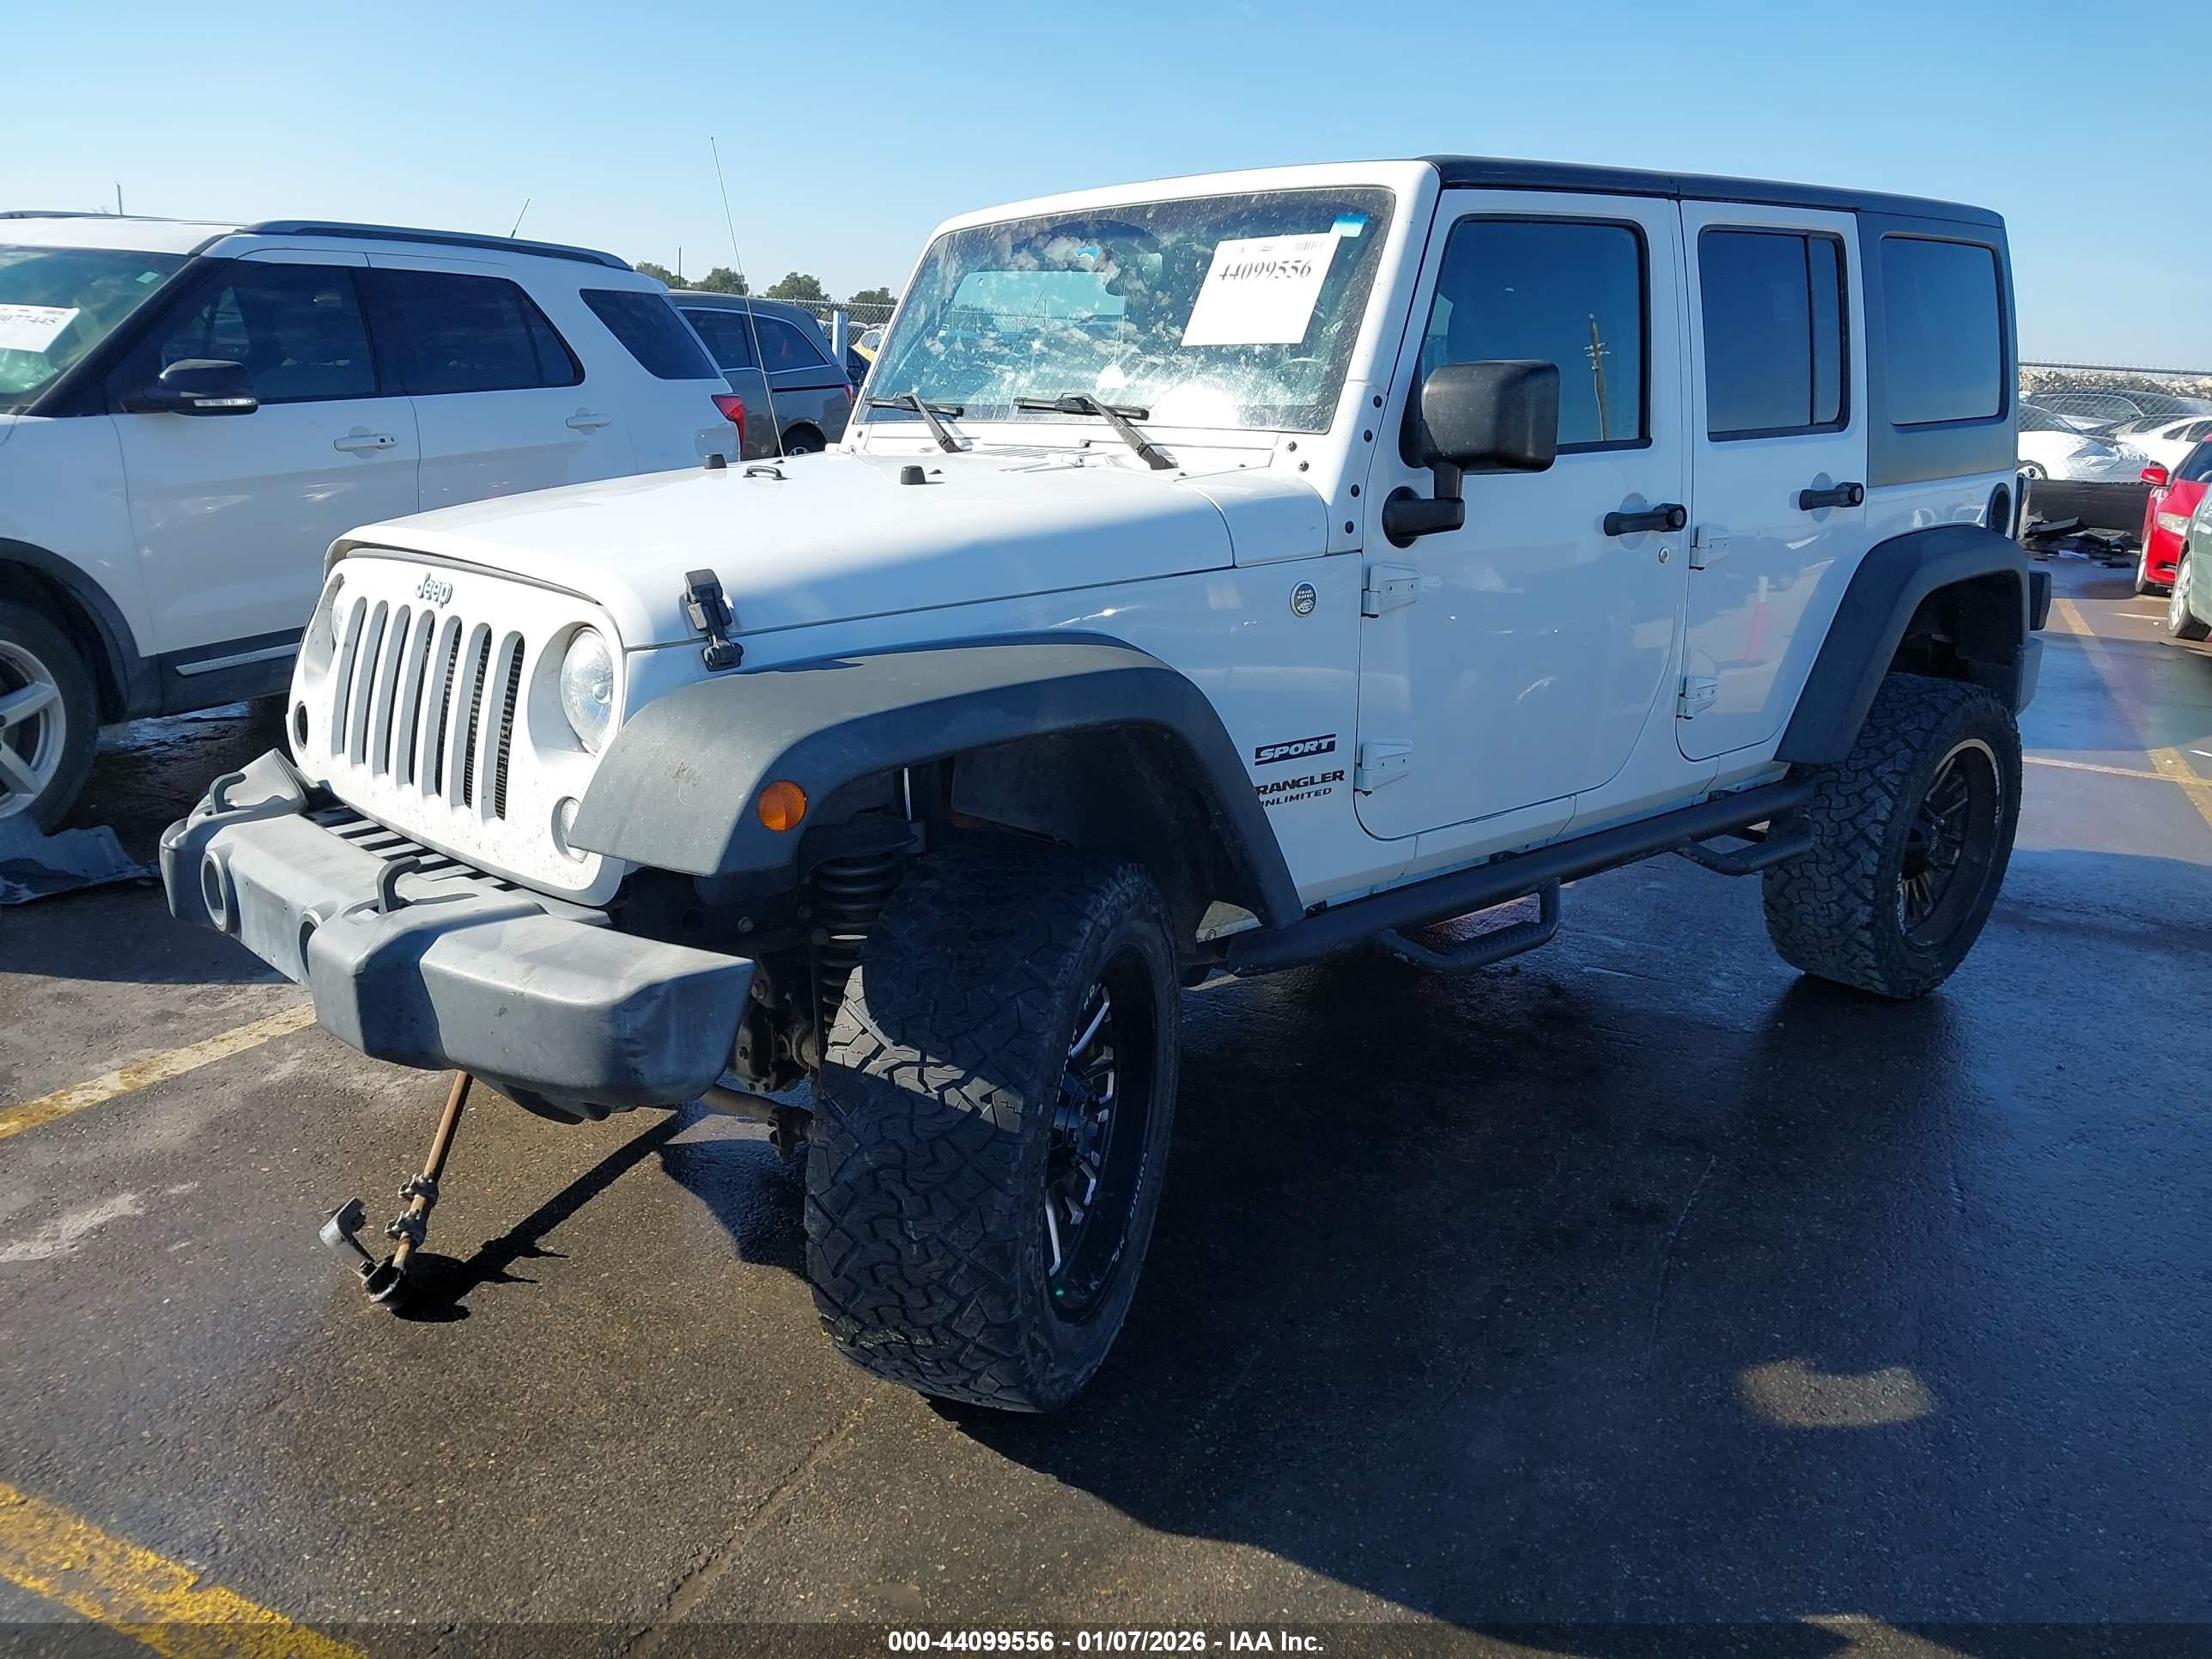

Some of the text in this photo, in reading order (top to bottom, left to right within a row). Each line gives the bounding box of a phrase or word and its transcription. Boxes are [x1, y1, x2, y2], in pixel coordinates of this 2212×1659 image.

[1218, 259, 1312, 281] 44099556
[416, 572, 453, 609] Jeep
[1257, 738, 1335, 761] SPORT
[1255, 769, 1345, 795] RANGLER
